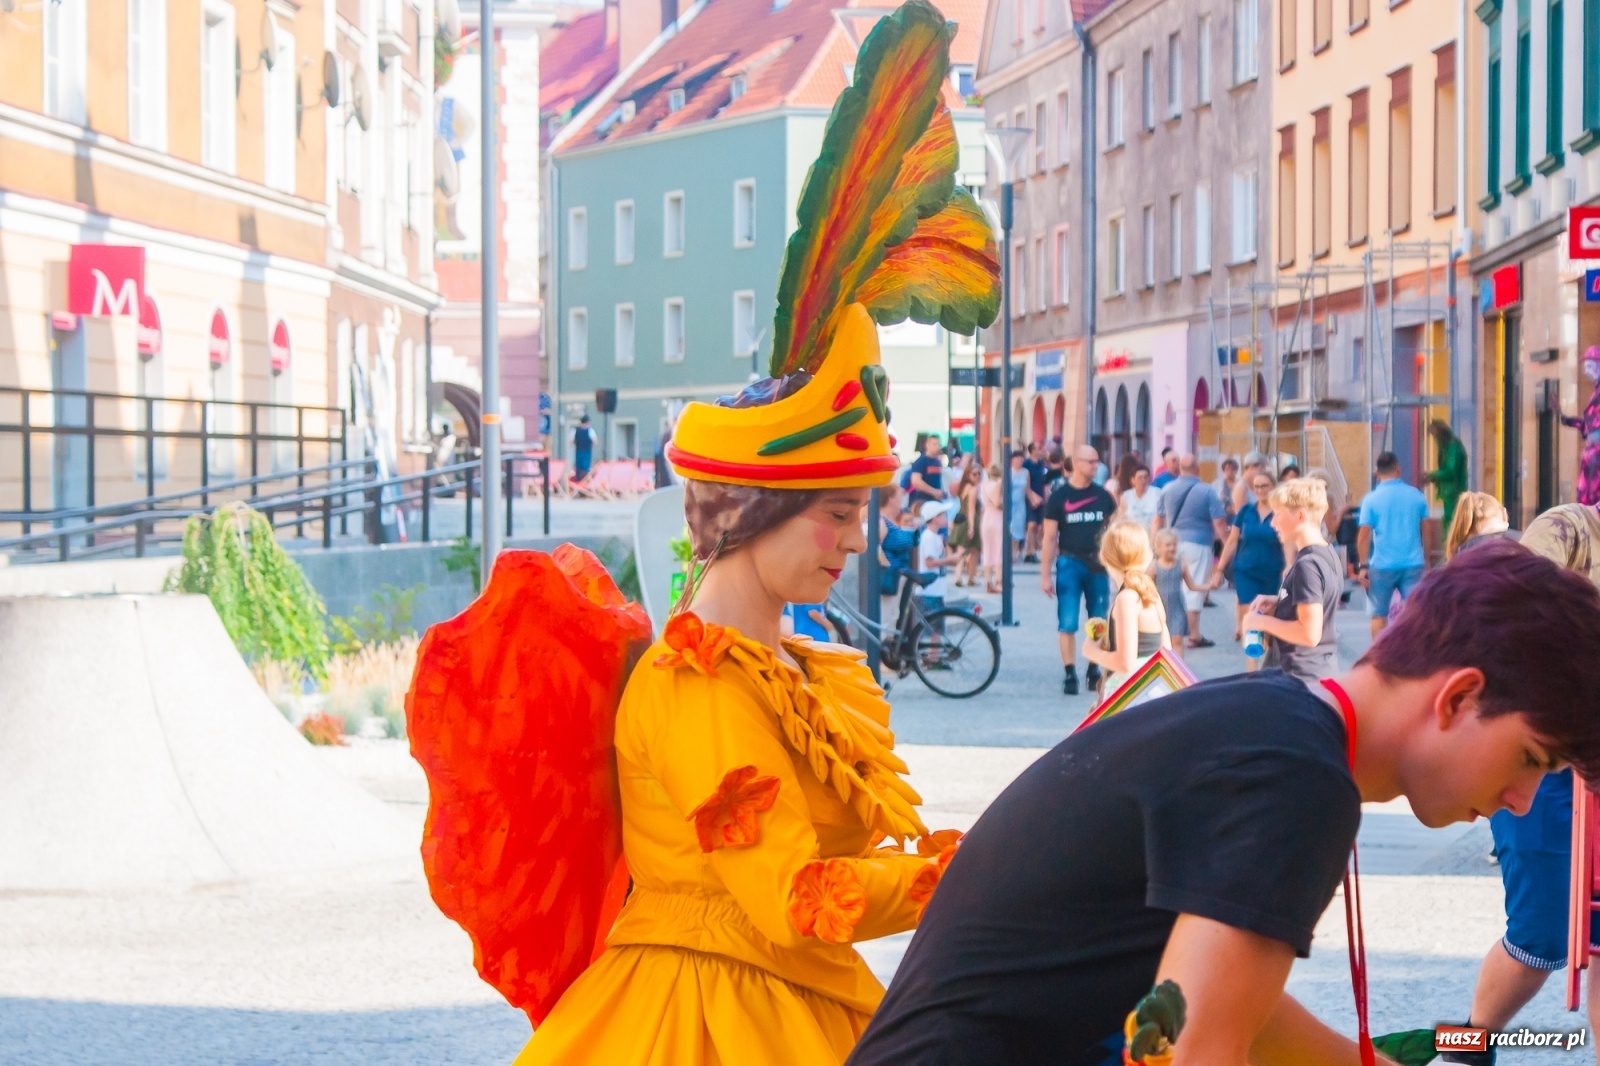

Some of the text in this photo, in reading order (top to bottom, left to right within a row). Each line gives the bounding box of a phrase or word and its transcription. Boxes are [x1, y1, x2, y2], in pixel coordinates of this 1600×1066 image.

[91, 268, 139, 316] M
[1067, 512, 1083, 523] JUST
[1084, 512, 1095, 522] DO
